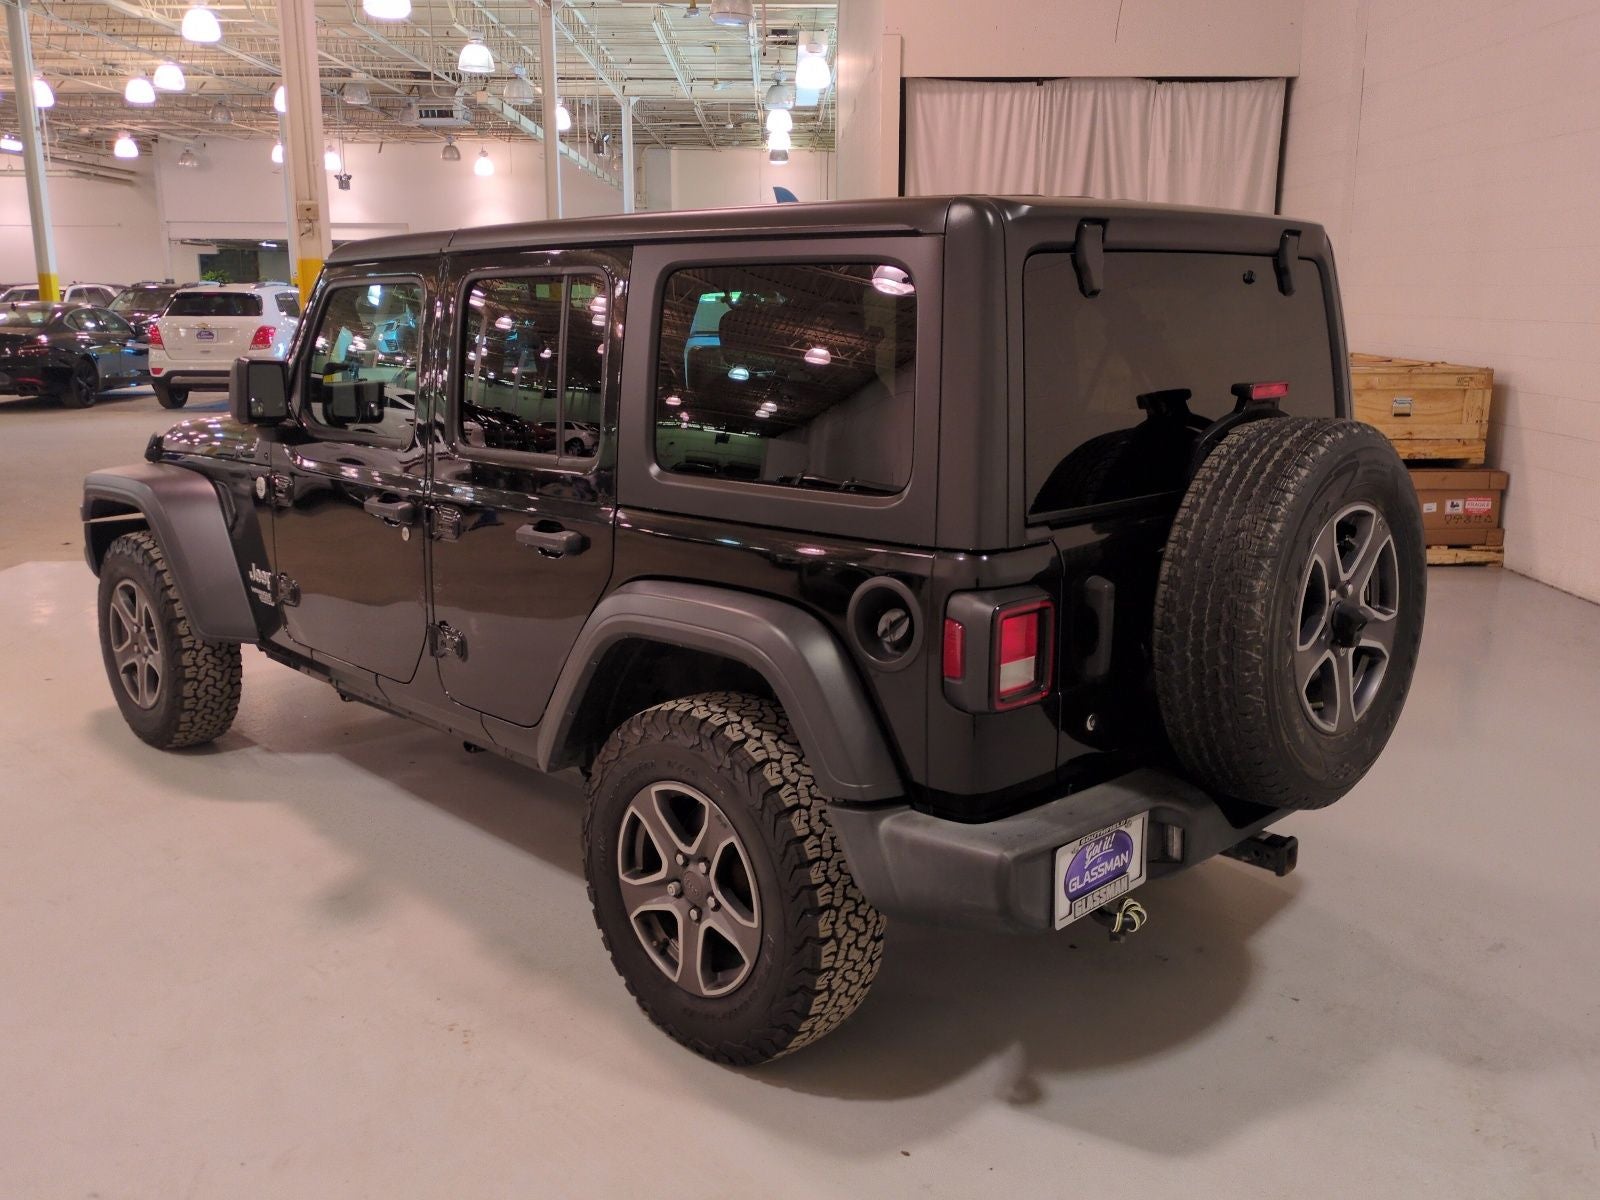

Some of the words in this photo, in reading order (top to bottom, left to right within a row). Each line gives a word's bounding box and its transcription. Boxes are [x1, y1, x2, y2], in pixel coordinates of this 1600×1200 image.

[248, 563, 271, 590] Jeep
[1068, 851, 1129, 893] GLASSMAN
[1075, 876, 1129, 914] GLASSMAN
